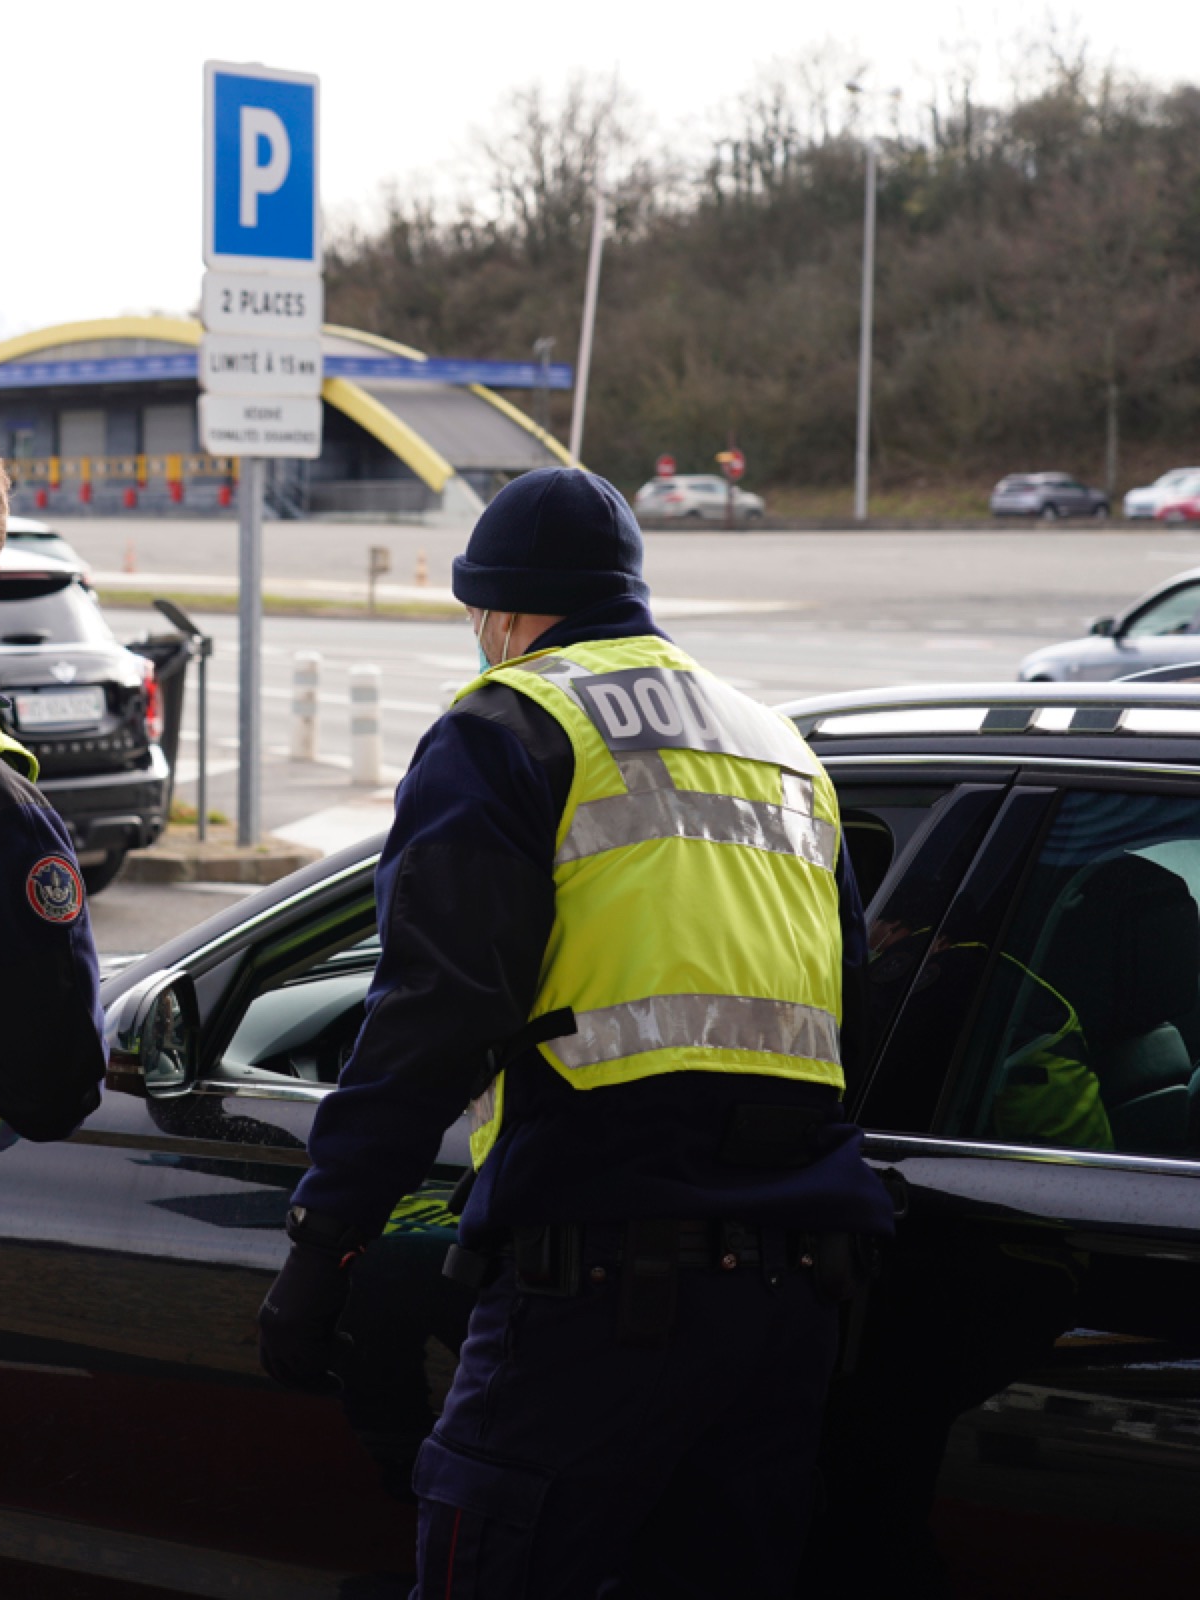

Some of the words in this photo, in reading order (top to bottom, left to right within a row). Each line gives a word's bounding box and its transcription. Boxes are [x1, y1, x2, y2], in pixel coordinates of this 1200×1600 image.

[239, 105, 291, 228] P
[221, 288, 233, 315] 2
[240, 289, 306, 317] PLACES
